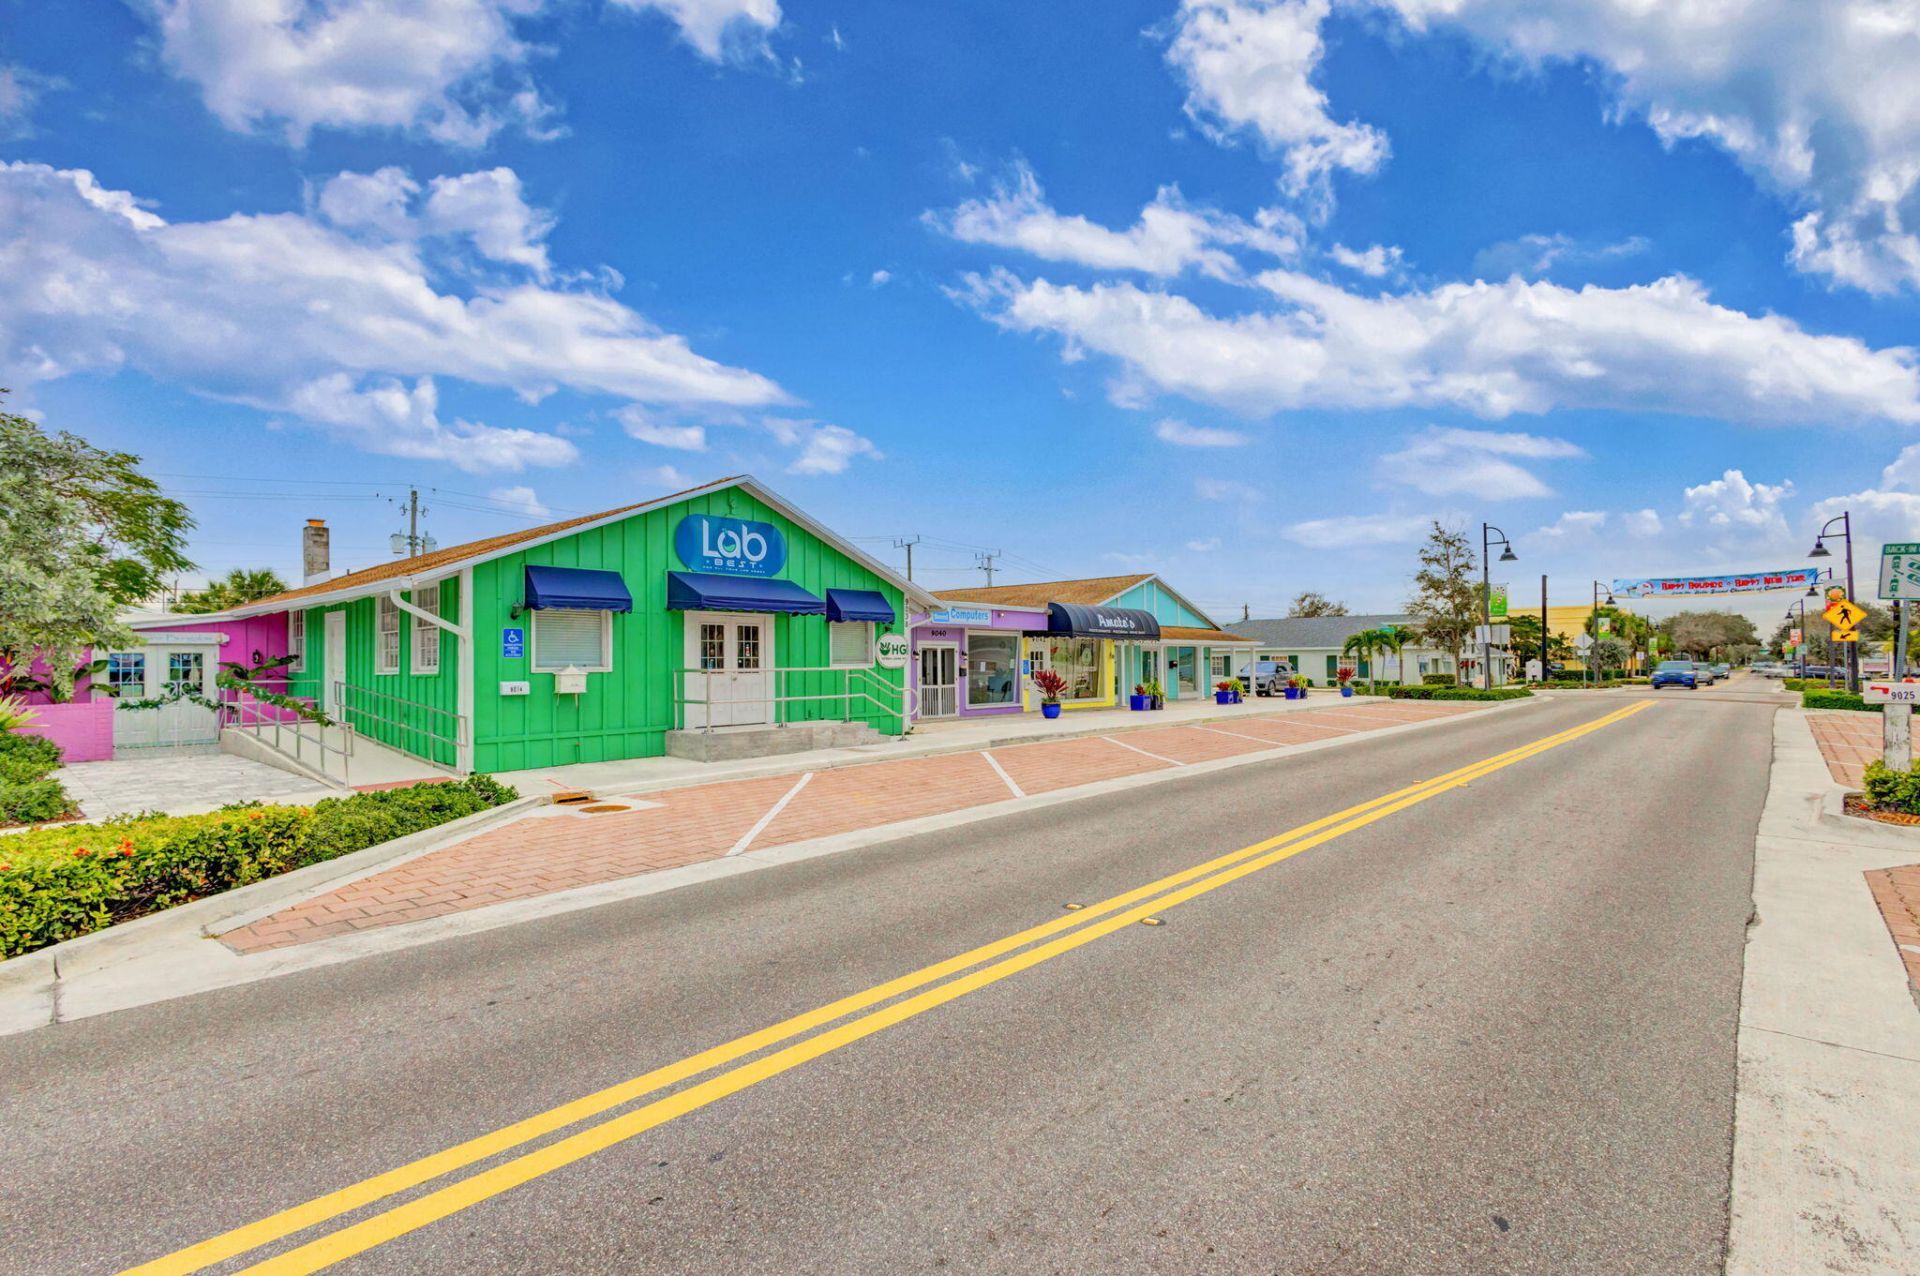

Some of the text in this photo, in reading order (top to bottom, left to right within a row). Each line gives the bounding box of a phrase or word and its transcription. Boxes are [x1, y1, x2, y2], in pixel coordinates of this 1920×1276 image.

[702, 518, 768, 562] Lab
[714, 558, 758, 569] BEST
[950, 607, 989, 622] Computers
[931, 629, 947, 637] 9040
[1890, 690, 1916, 701] 9025
